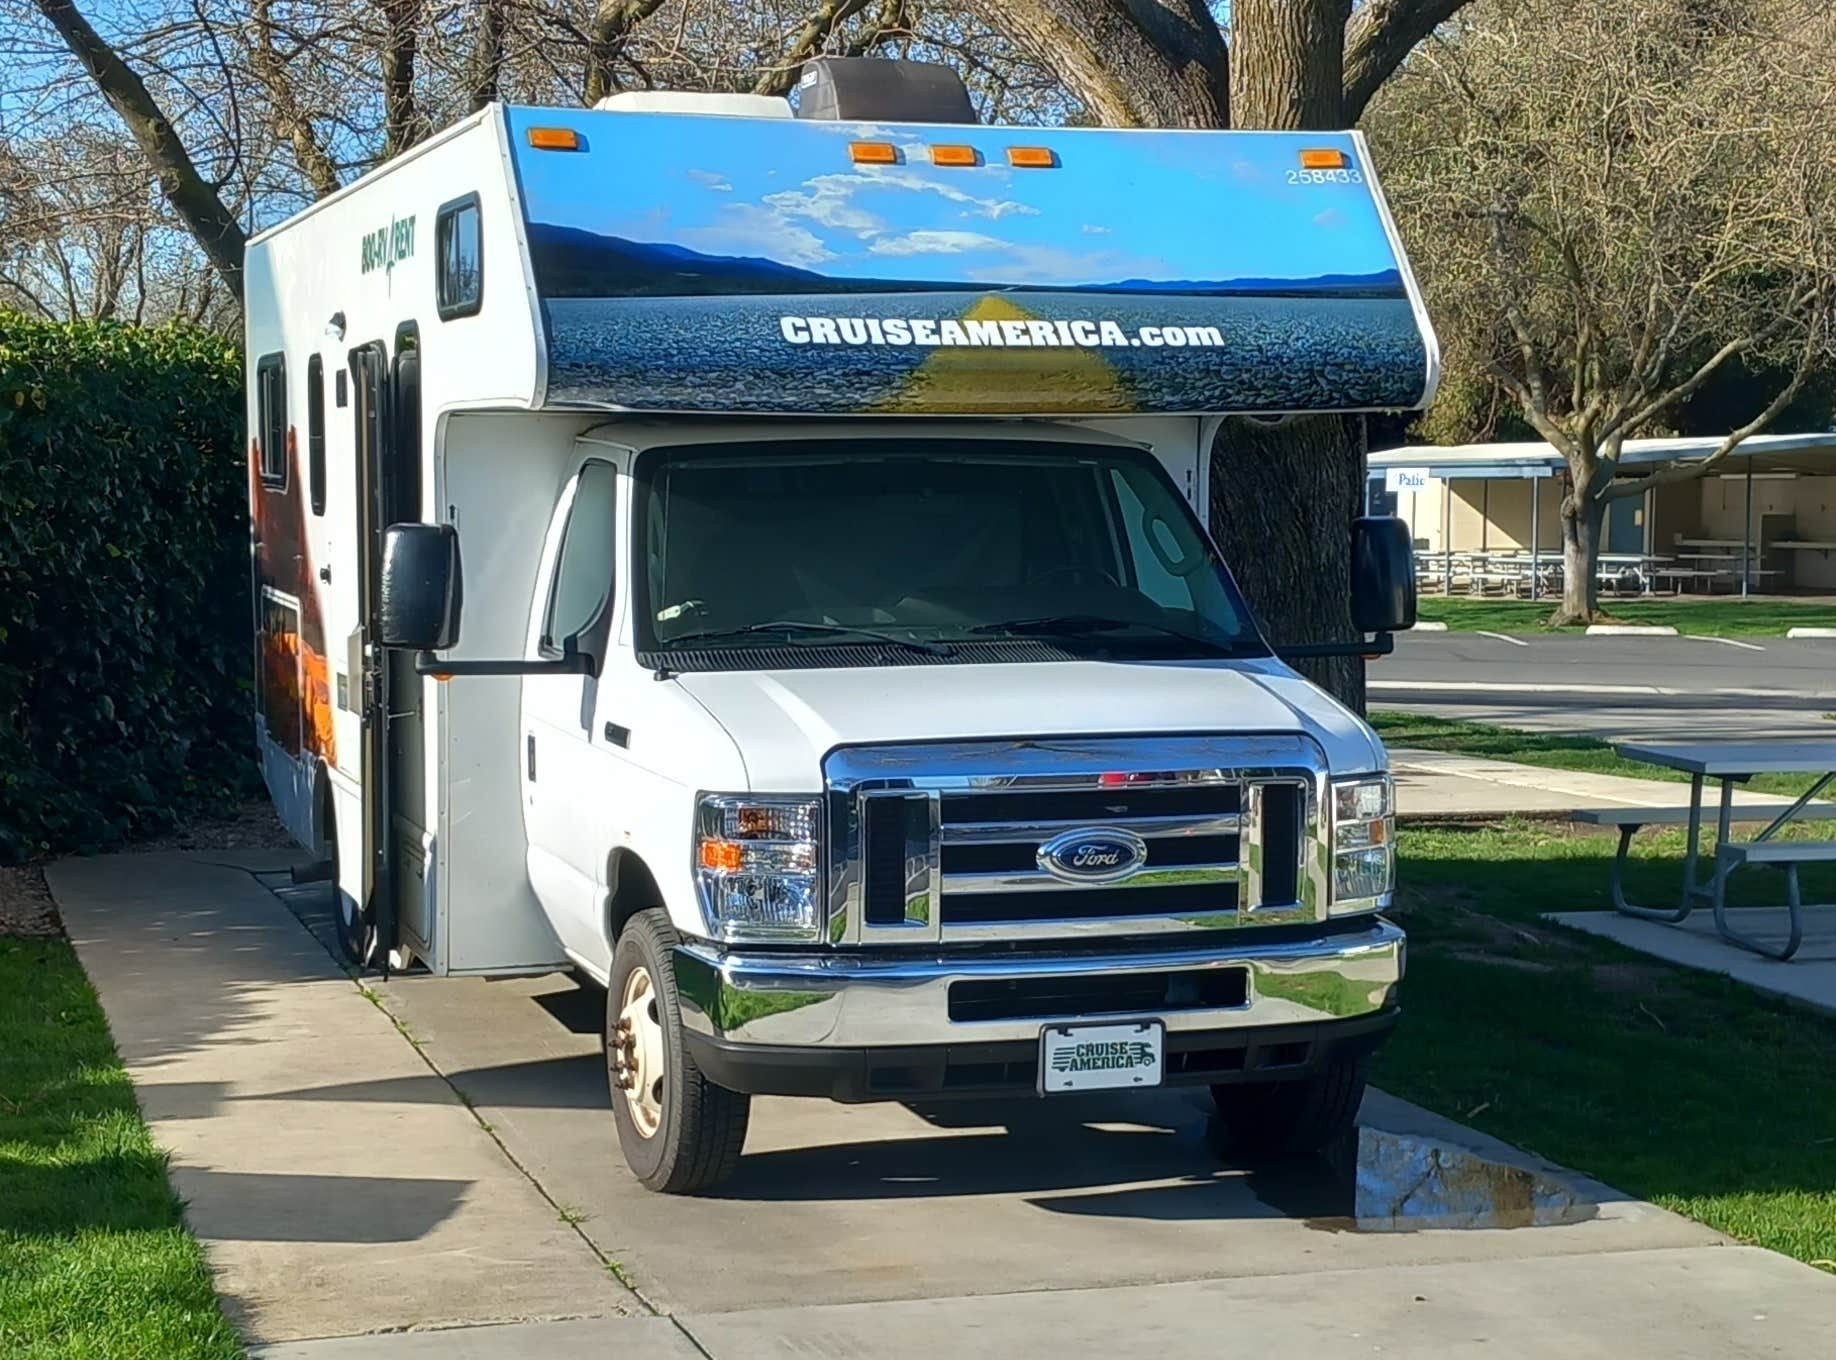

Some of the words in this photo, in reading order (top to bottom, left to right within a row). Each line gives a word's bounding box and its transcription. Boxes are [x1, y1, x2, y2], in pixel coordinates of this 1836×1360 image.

[1286, 169, 1362, 185] 258433
[779, 316, 1225, 347] CRUISEAMERICA.com
[1072, 844, 1119, 866] Ford
[1076, 1042, 1128, 1057] CRUISE
[1069, 1055, 1135, 1072] AMERICA
